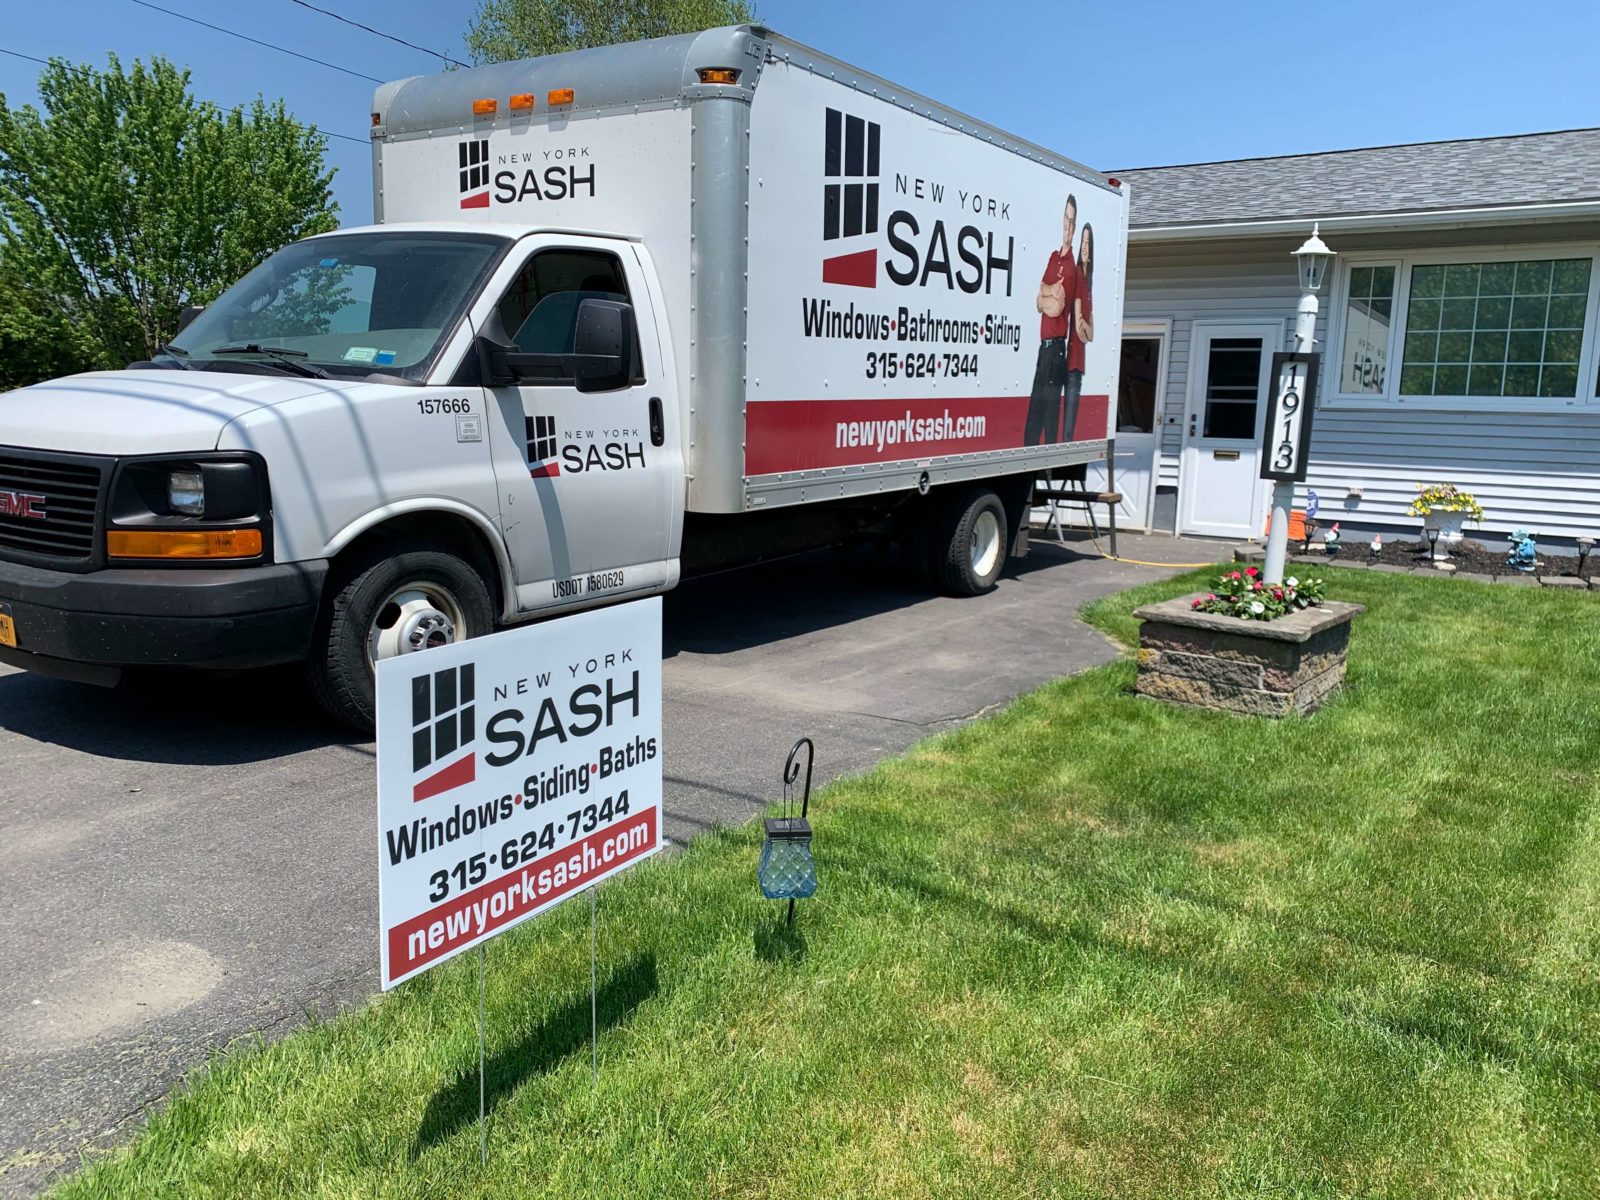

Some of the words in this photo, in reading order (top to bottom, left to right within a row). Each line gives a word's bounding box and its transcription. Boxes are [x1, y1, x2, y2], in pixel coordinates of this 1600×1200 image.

[499, 152, 532, 165] NEW
[543, 147, 590, 160] YORK
[494, 163, 595, 204] SASH
[896, 173, 944, 203] NEW
[958, 190, 1010, 220] YORK
[884, 210, 1015, 297] SASH
[802, 297, 890, 341] Windows
[897, 306, 979, 344] Bathrooms
[984, 314, 1021, 351] Siding
[417, 398, 471, 414] 157666
[564, 430, 594, 439] NEW
[603, 428, 639, 437] YORK
[835, 409, 986, 452] newyorksash.com
[562, 442, 646, 473] SASH
[552, 579, 583, 599] USDOT
[586, 571, 624, 592] 1580629
[493, 672, 551, 701] NEW
[568, 648, 633, 678] YORK
[484, 670, 640, 767] SASH
[386, 794, 513, 866] Windows
[523, 763, 590, 810] Siding
[599, 734, 657, 779] Baths
[407, 822, 649, 961] newyorksash.com
